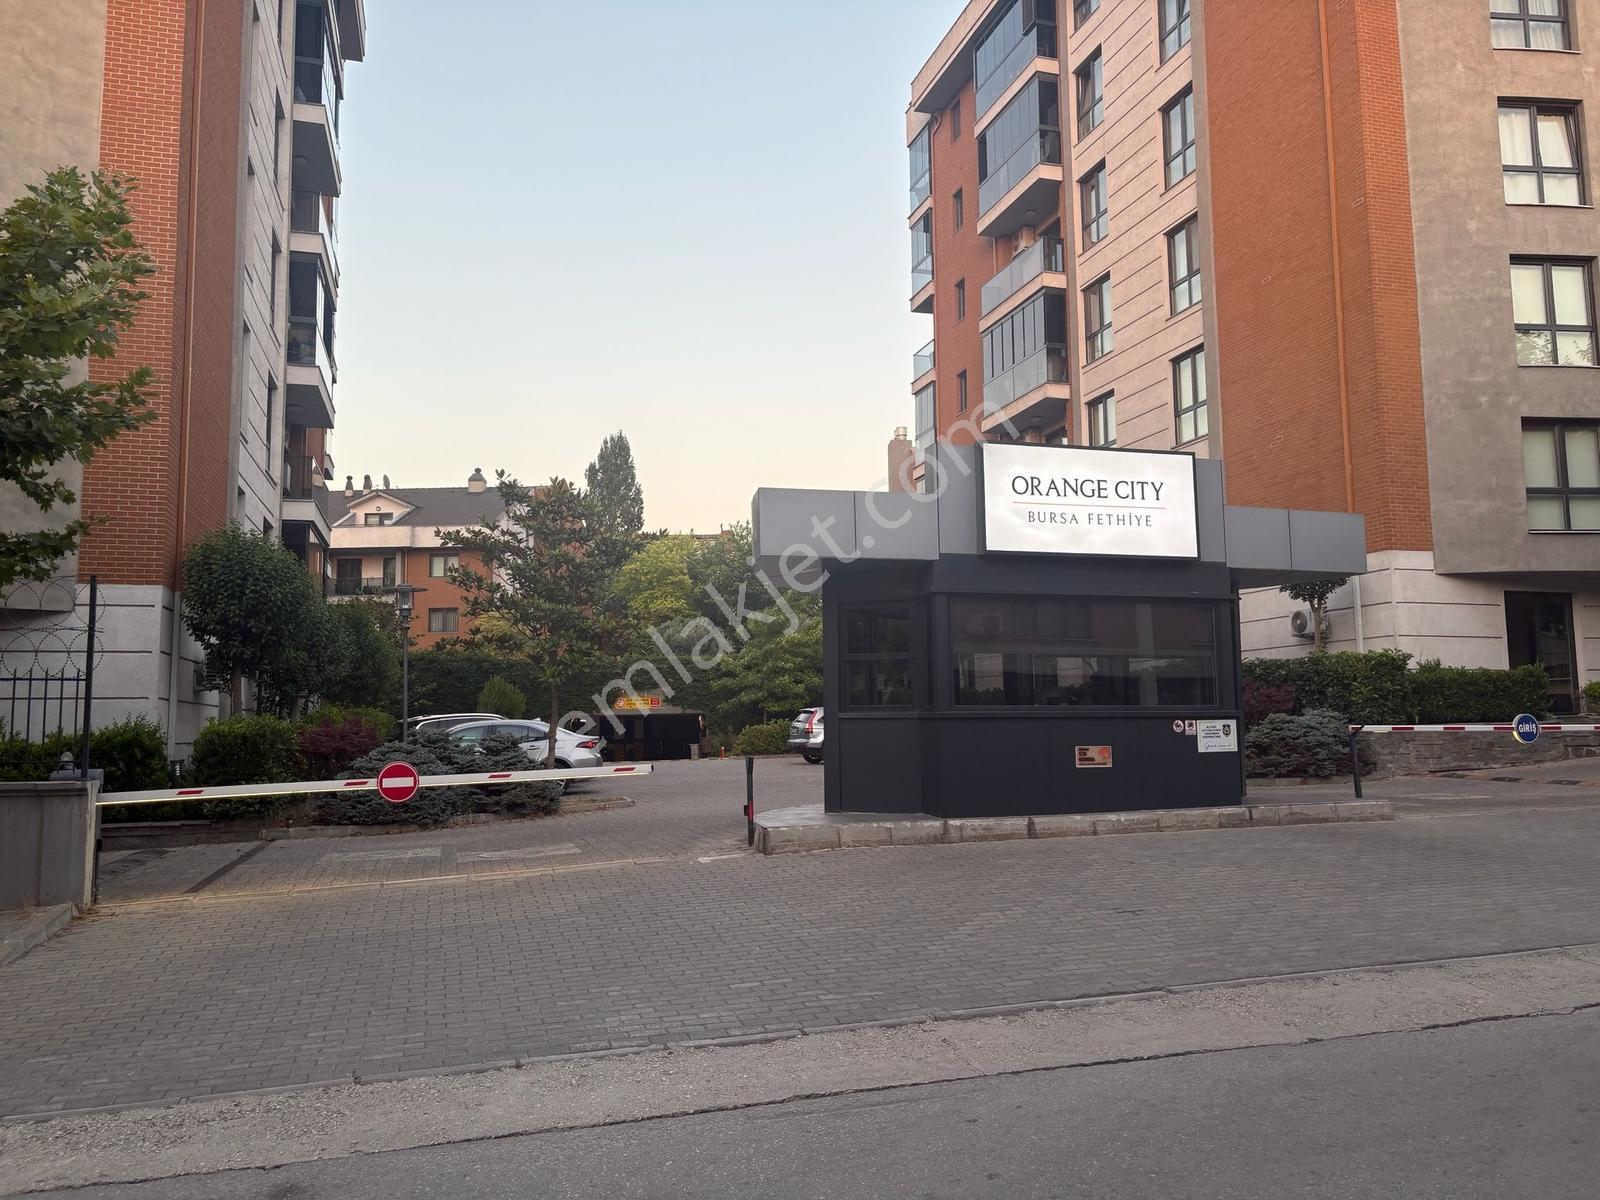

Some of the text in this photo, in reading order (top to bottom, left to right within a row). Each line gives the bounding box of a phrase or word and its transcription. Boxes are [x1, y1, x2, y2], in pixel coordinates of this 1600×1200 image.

[1011, 475, 1164, 501] ORANGE CITY
[1028, 511, 1152, 527] BURSA FETHİYE
[1518, 722, 1537, 734] GİRİŞ
